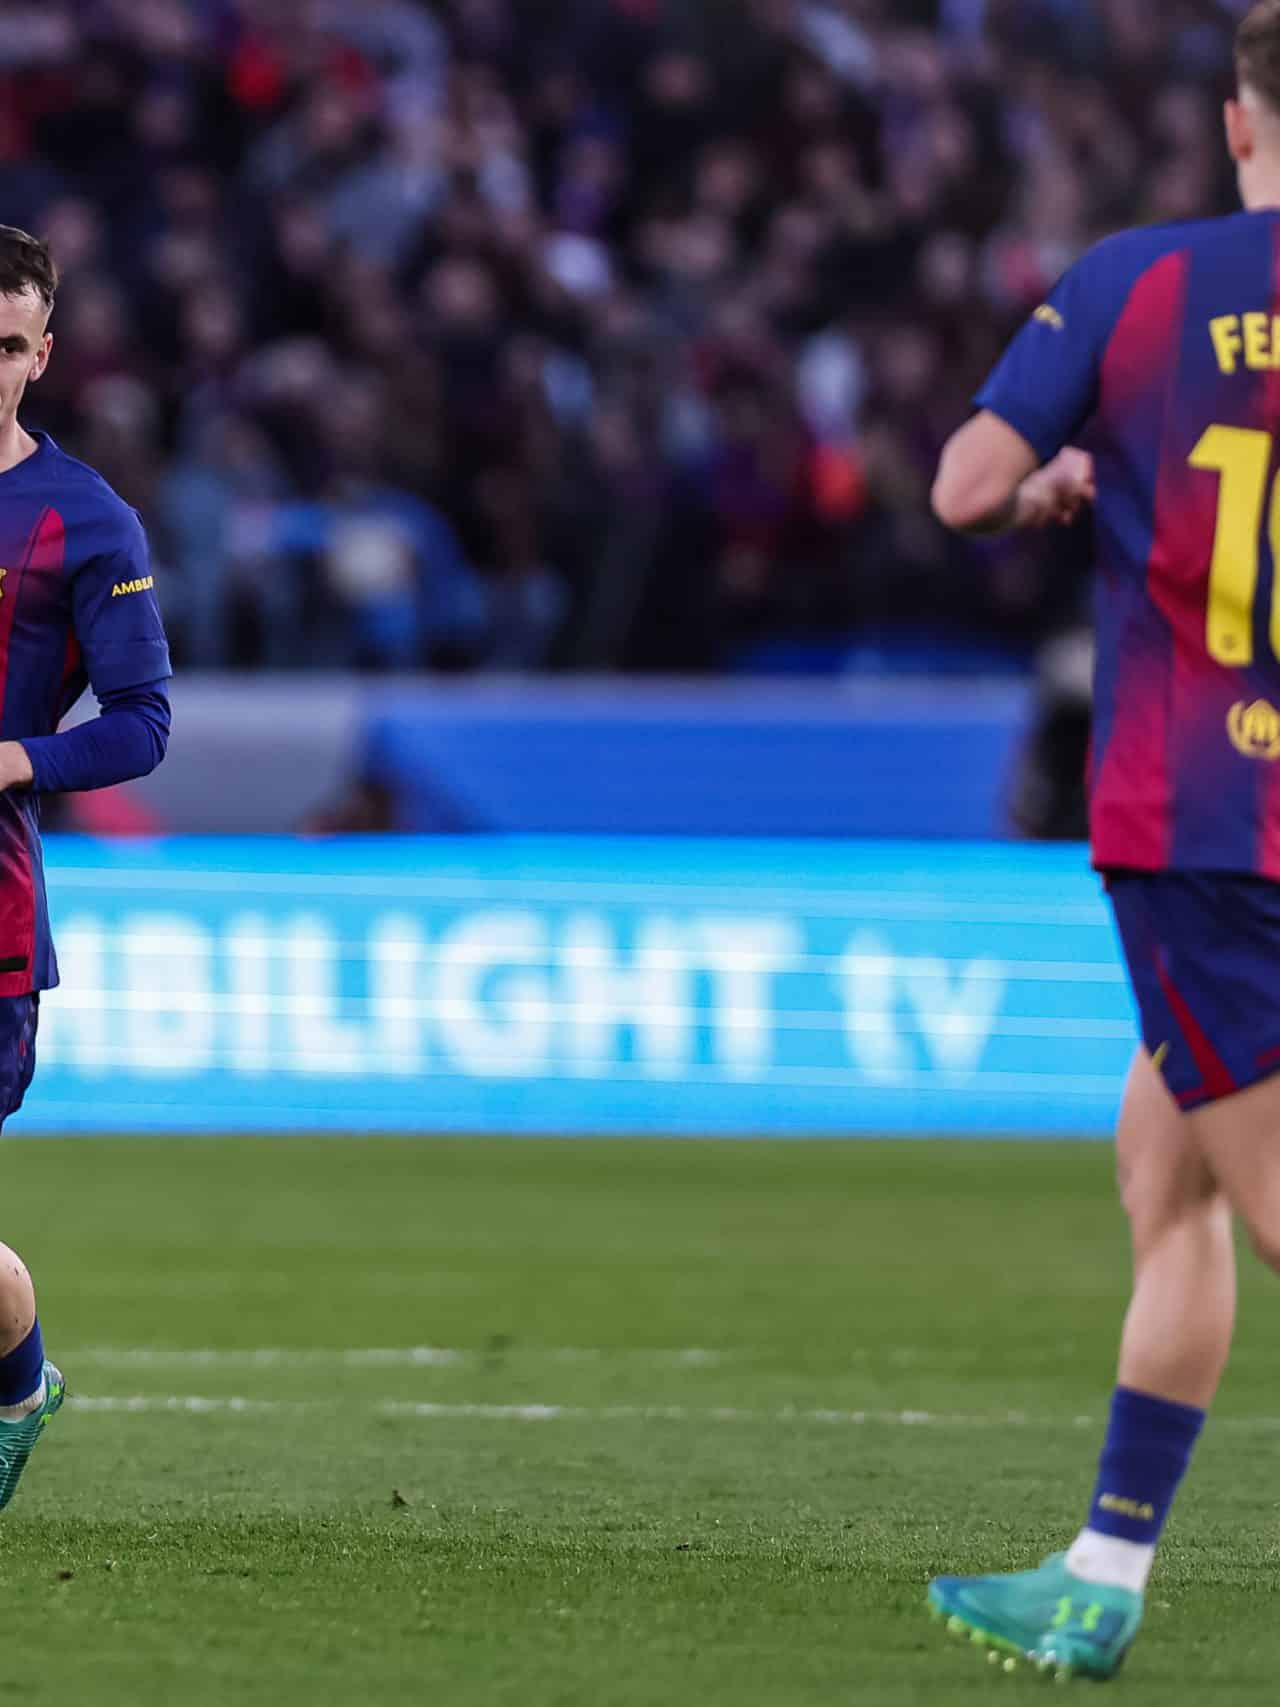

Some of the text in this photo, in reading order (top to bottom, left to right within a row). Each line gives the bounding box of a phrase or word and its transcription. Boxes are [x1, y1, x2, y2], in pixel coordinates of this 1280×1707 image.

[1209, 312, 1280, 374] FE
[1188, 423, 1280, 666] 1
[837, 926, 1004, 1087] tv
